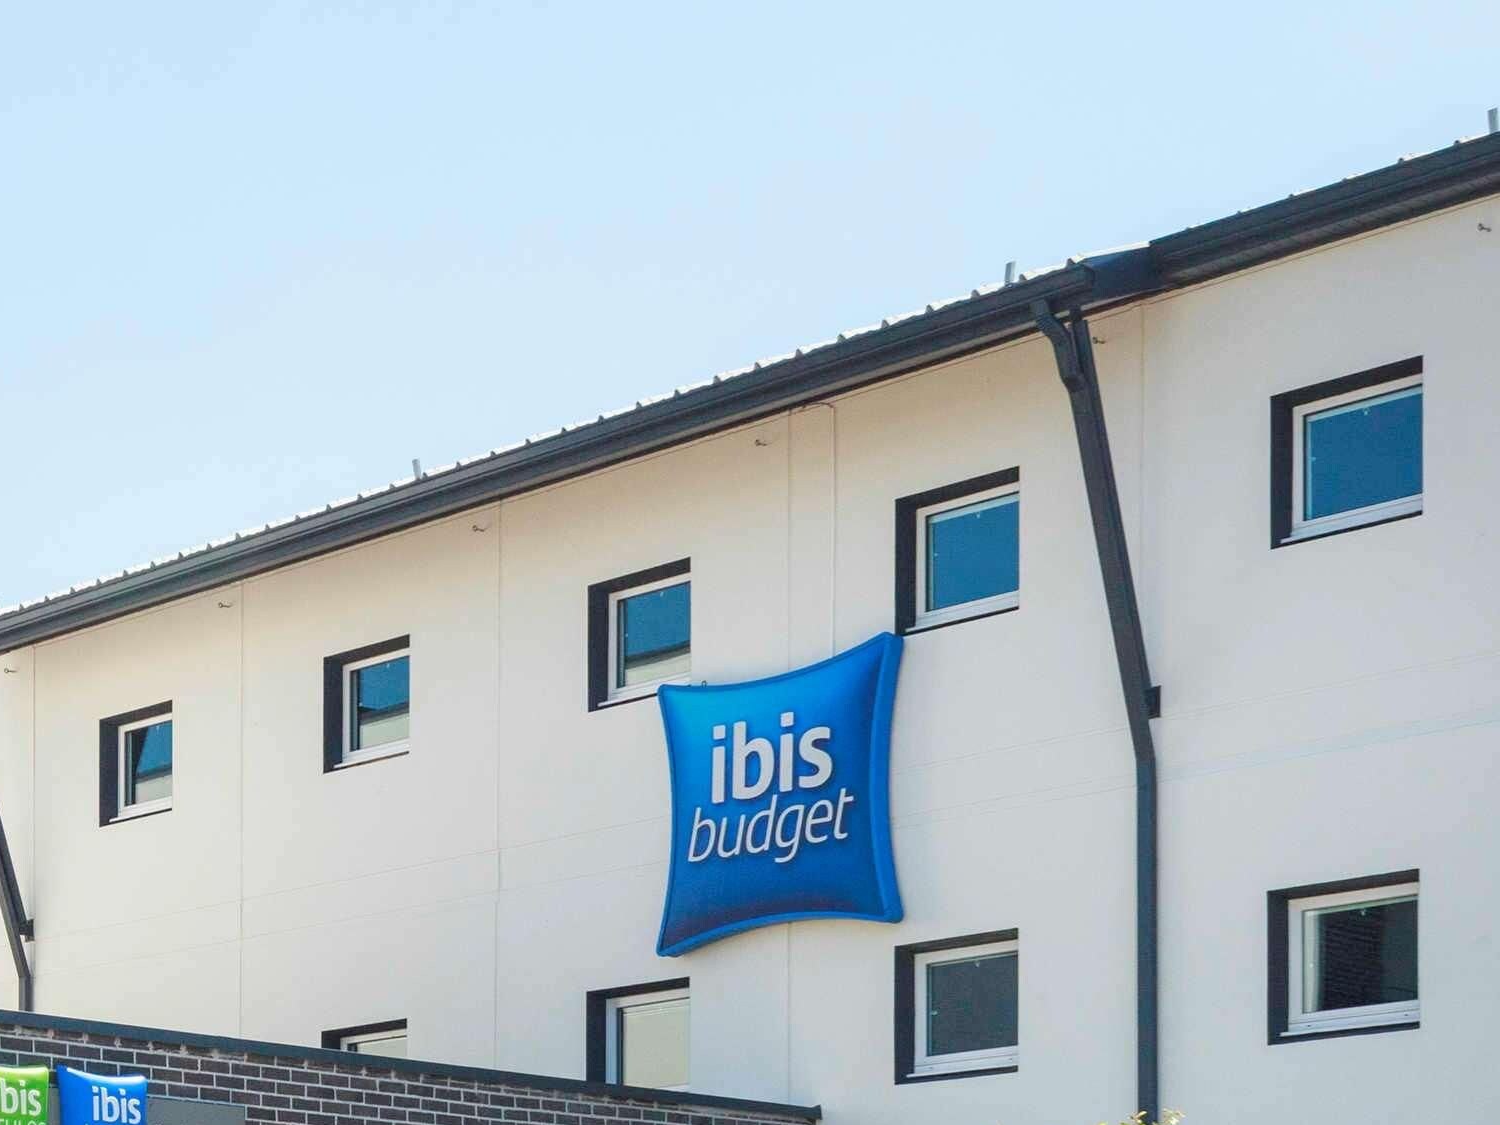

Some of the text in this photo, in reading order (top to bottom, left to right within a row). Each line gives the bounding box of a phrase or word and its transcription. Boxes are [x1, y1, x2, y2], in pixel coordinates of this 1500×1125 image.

[711, 712, 833, 804] ibis
[687, 788, 854, 863] budget
[92, 1086, 141, 1125] ibis
